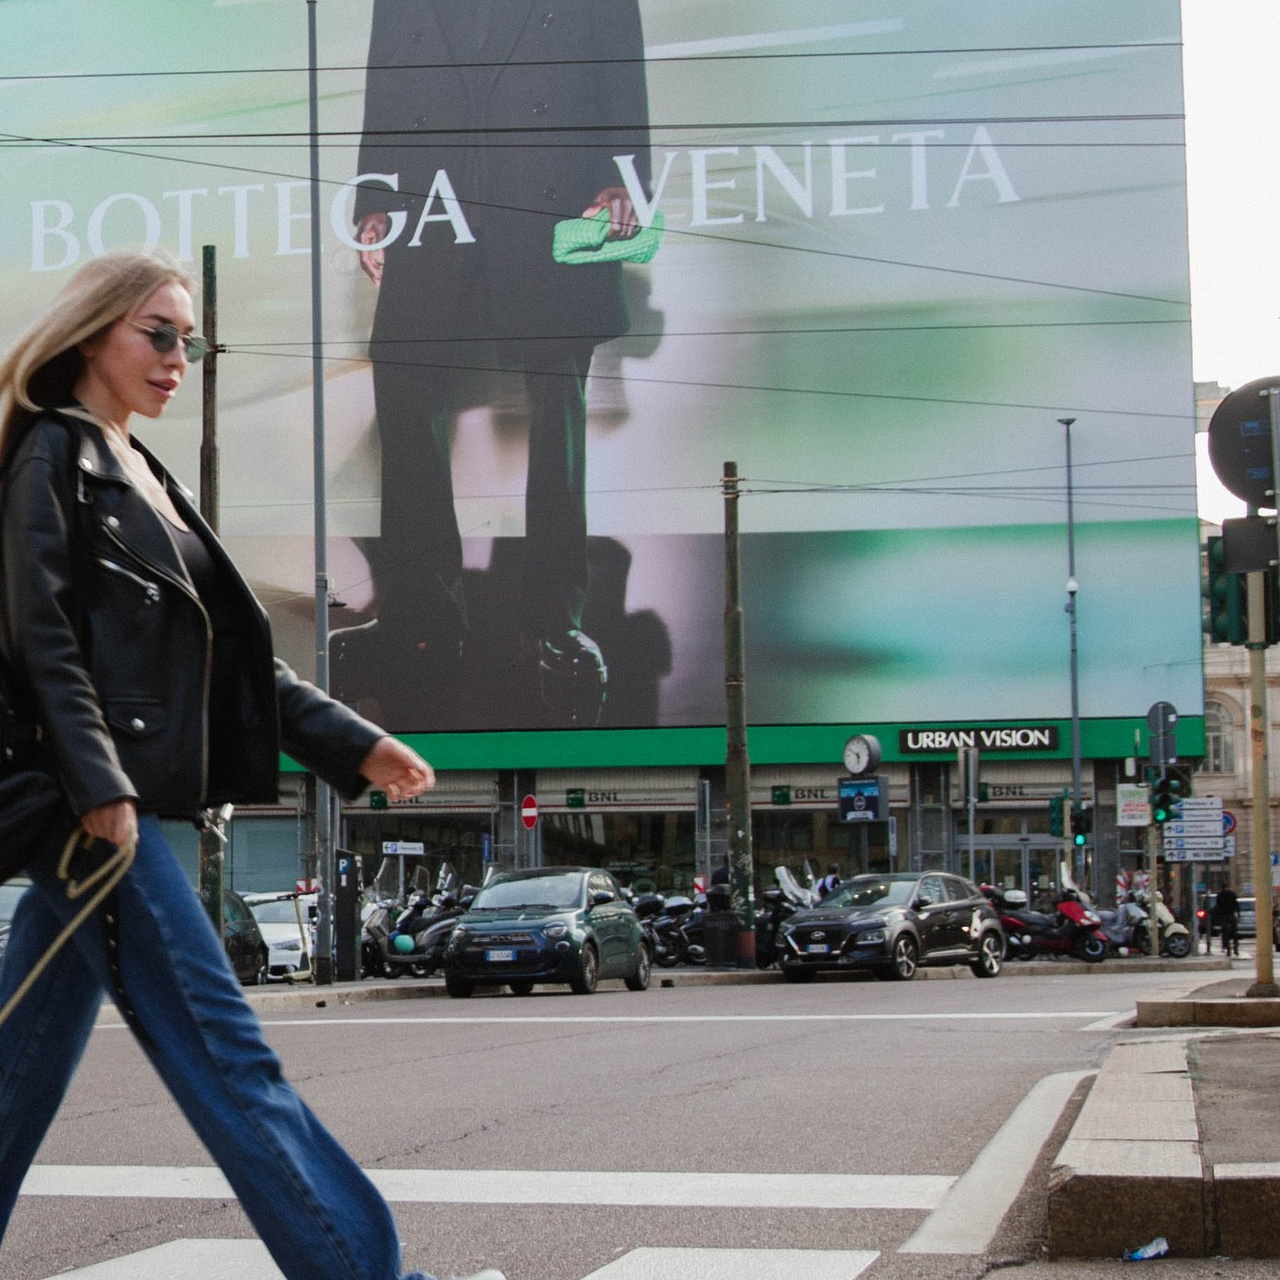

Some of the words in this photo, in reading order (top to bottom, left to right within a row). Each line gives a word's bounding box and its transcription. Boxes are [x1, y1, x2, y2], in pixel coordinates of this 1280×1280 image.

[28, 169, 476, 273] BOTTEGA
[613, 126, 1020, 228] VENETA
[907, 731, 975, 749] URBAN
[980, 729, 1049, 747] VISION
[794, 789, 830, 799] BNL
[992, 786, 1029, 796] BNL
[588, 792, 622, 802] BNL
[339, 859, 348, 871] P
